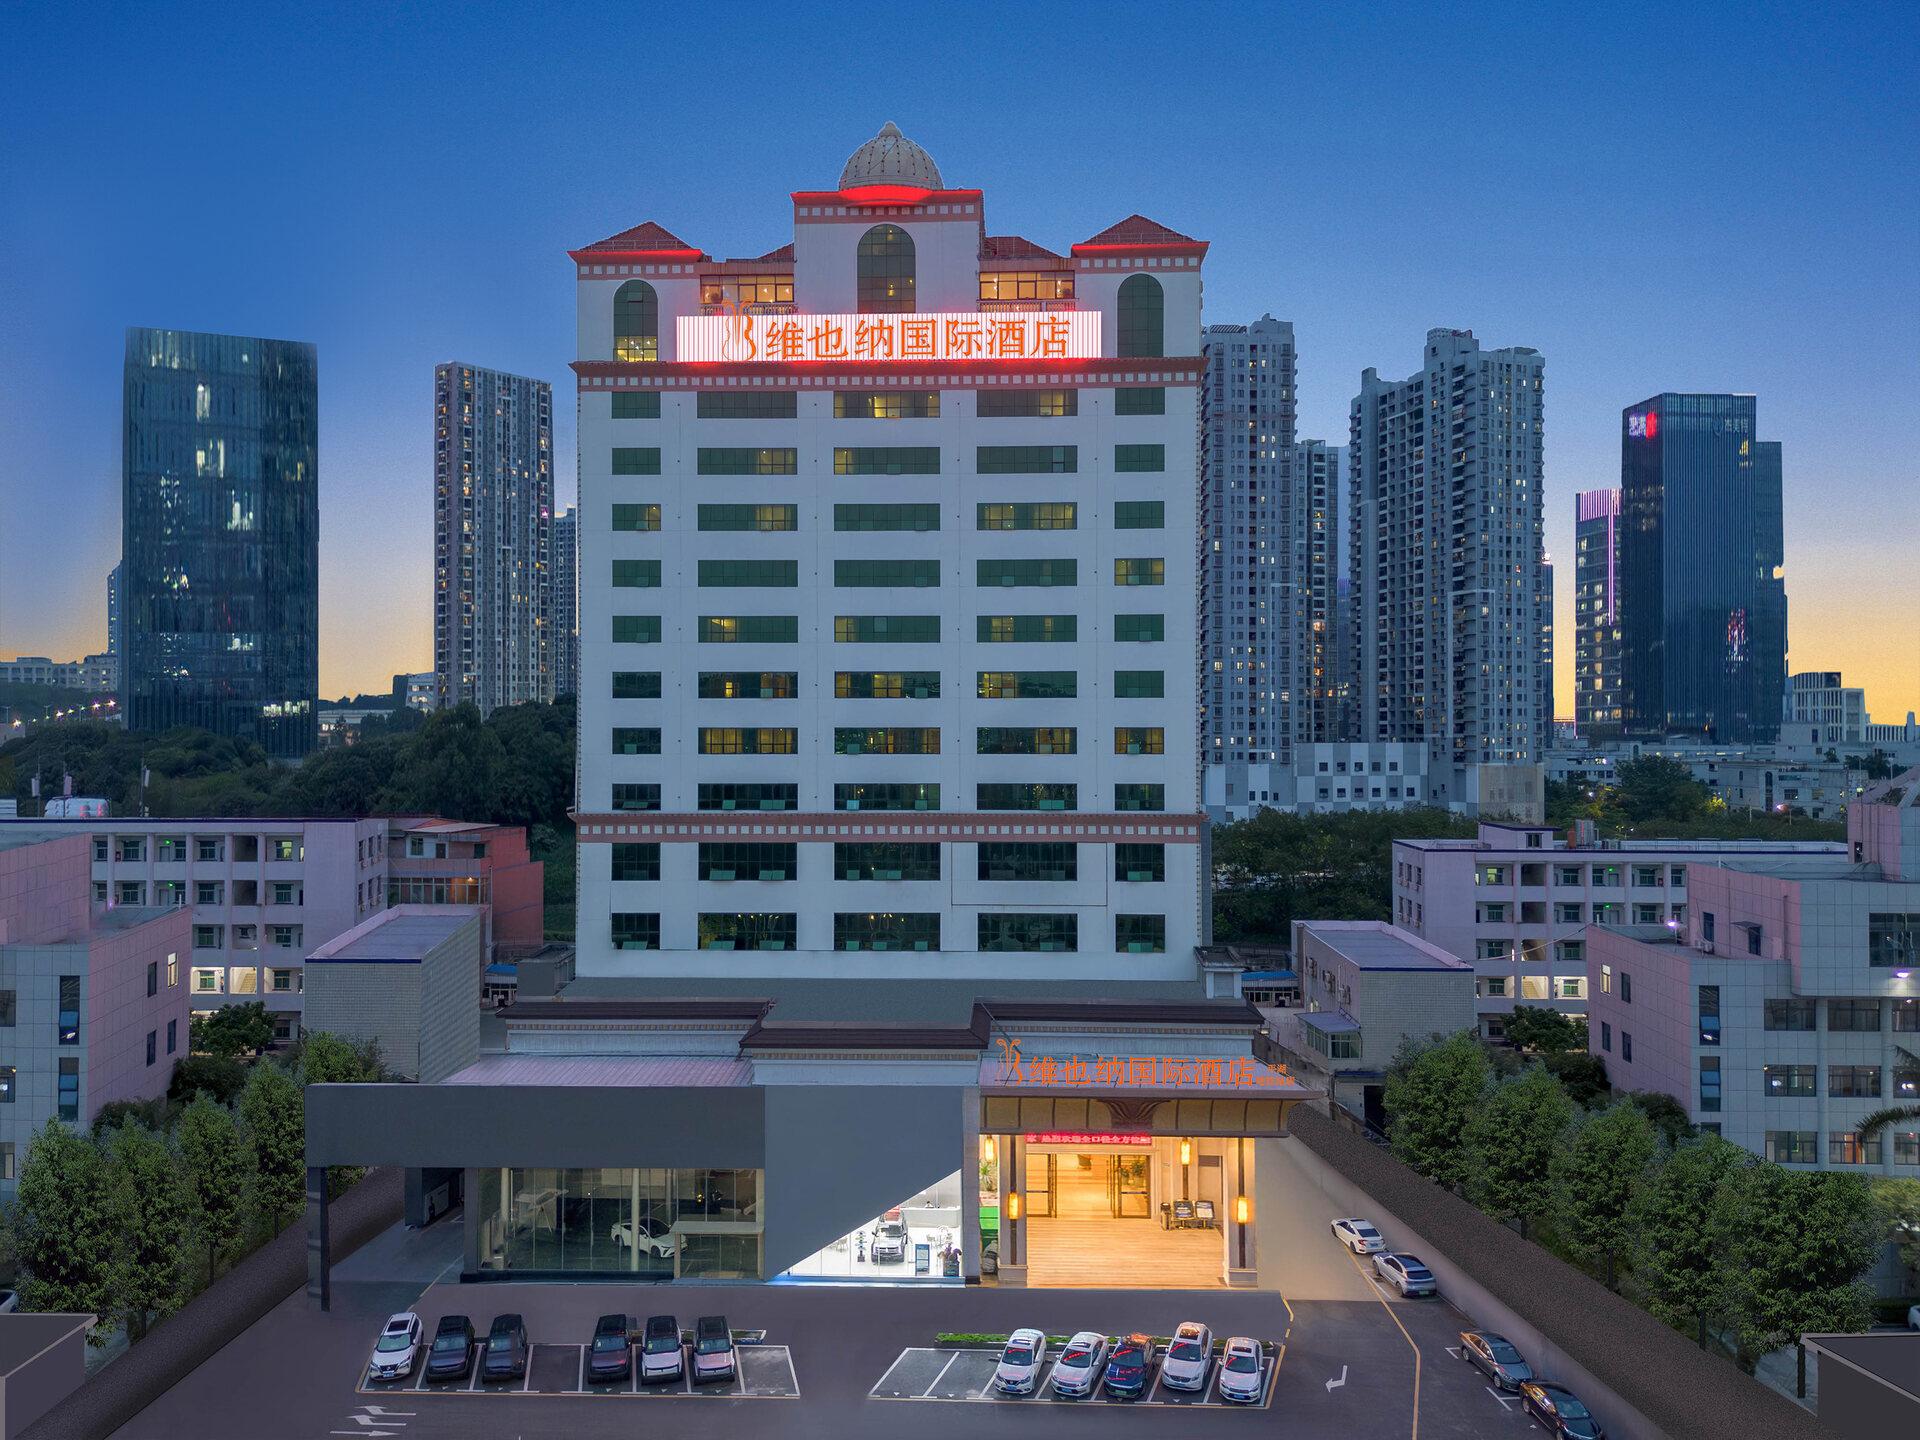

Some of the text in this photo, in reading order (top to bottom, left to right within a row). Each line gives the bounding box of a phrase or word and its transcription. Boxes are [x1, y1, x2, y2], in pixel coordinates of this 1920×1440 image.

[766, 316, 1071, 358] 维也纳国际酒店
[1029, 1056, 1256, 1086] 维也纳国际酒店
